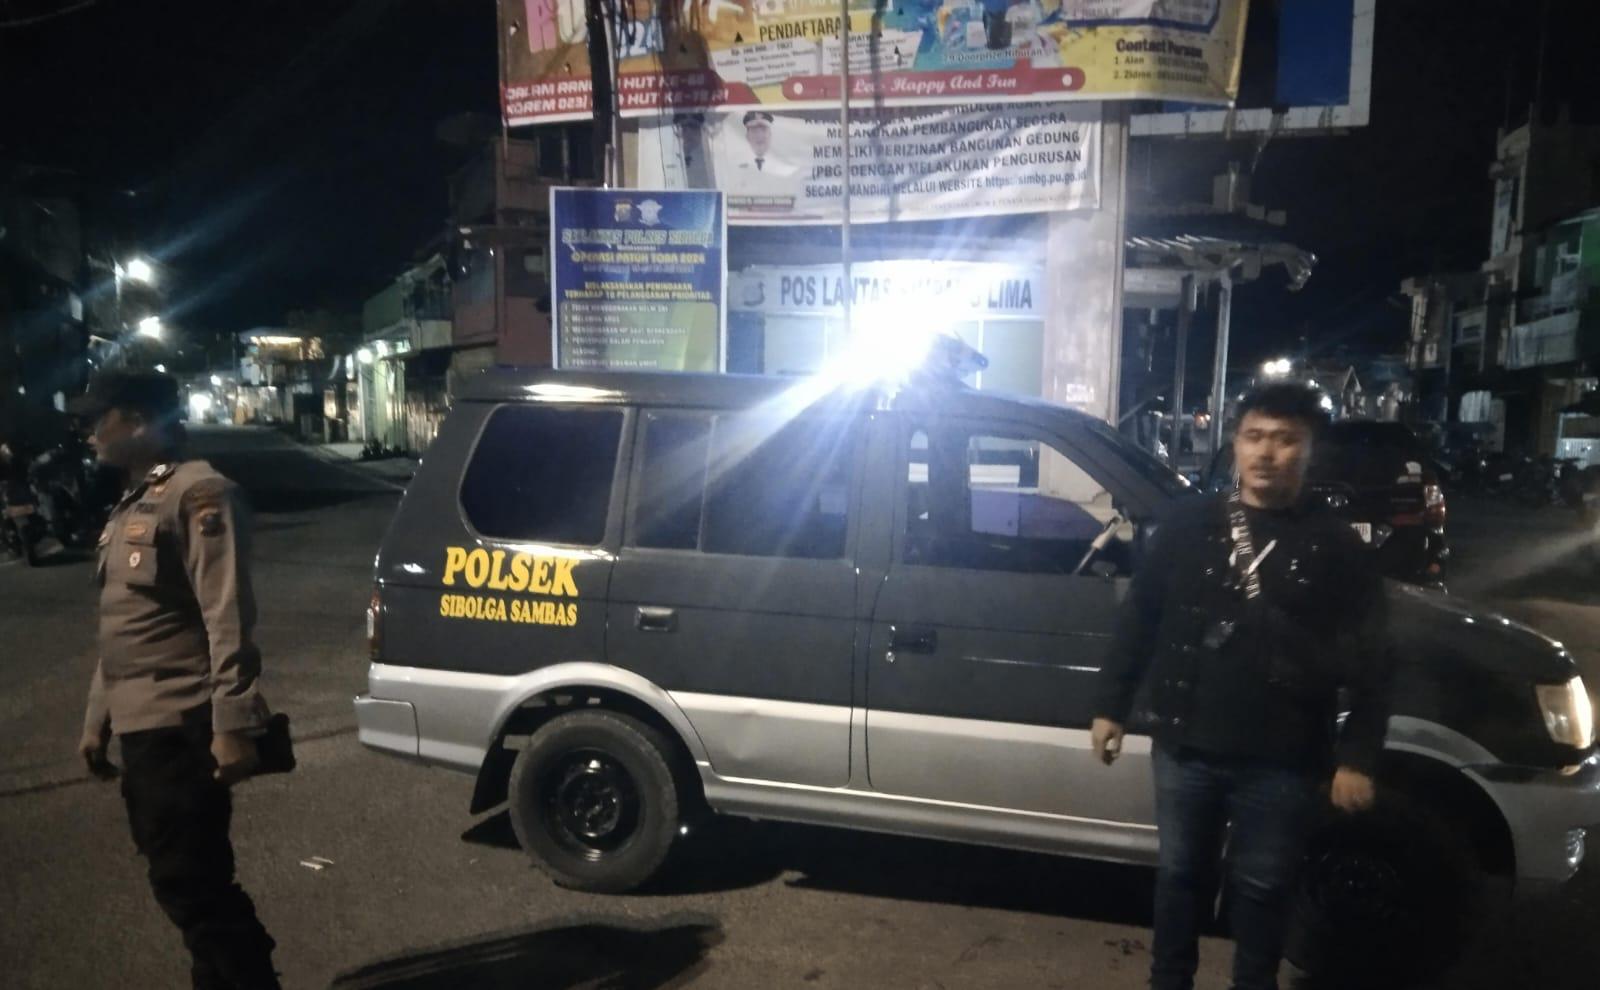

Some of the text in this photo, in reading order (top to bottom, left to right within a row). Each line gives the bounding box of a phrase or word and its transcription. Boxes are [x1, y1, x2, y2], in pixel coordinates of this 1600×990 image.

[623, 75, 656, 90] HUT
[891, 76, 945, 94] Happy
[950, 74, 983, 89] And
[986, 73, 1017, 88] Fun
[627, 92, 658, 105] HUT
[912, 117, 1012, 137] PEMBANGUNAN
[1016, 111, 1067, 129] SEGERA
[813, 144, 872, 159] MEMLIKI
[950, 136, 1022, 153] BANGUNAN
[1026, 130, 1080, 147] GEDUNG
[812, 149, 1081, 181] (PBG DENGAN MELAKUKAN PENGURUSAN
[938, 178, 983, 193] WEBSITE
[780, 275, 816, 306] POS
[988, 279, 1033, 310] LIMA
[442, 546, 580, 597] POLSEK
[440, 593, 578, 627] SIBOLGA SAMBAS
